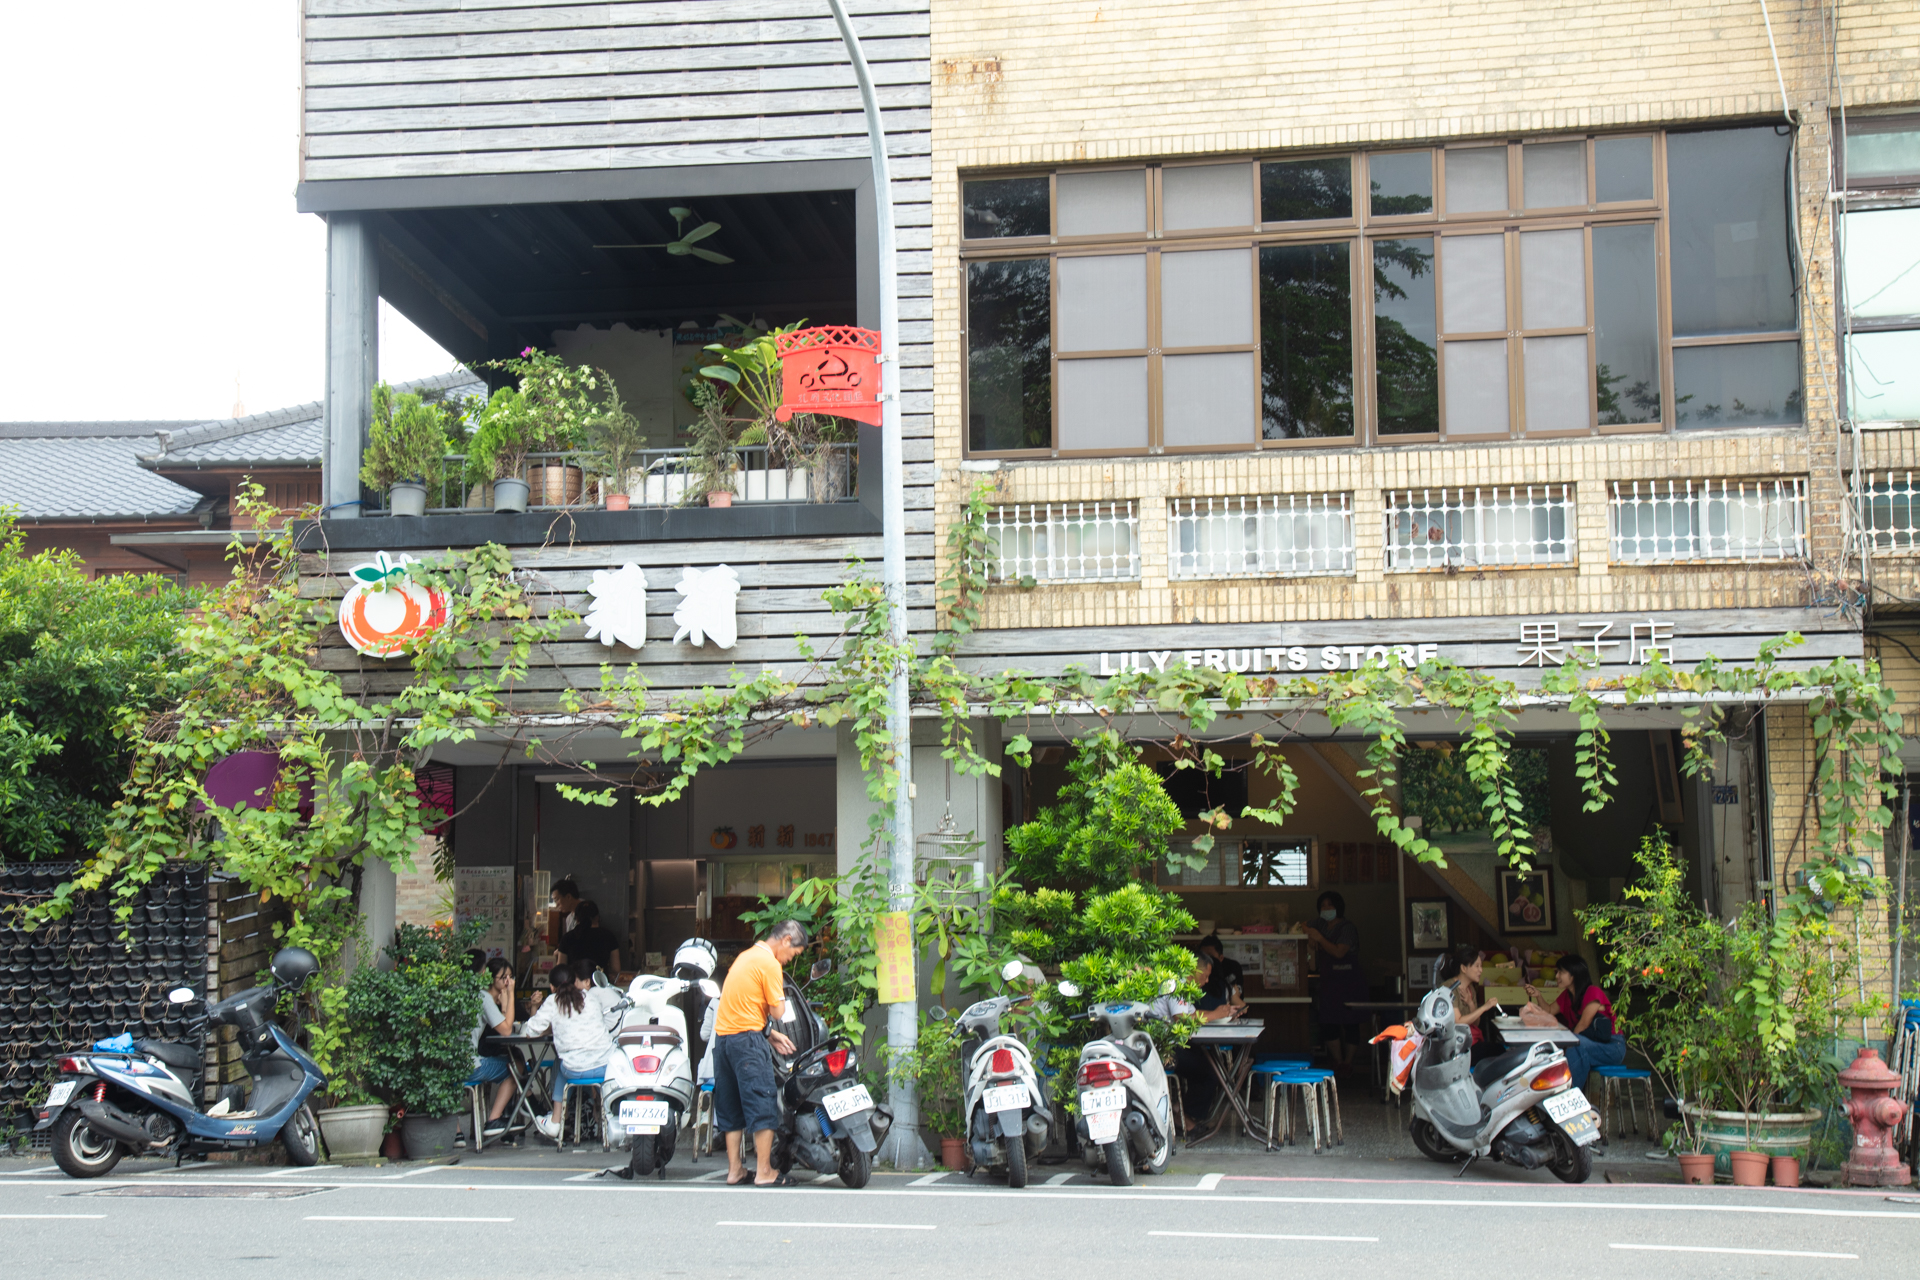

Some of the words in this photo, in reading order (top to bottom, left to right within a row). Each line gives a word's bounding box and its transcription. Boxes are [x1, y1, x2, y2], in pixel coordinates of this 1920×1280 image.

[1516, 618, 1675, 667] 果子店
[1100, 650, 1172, 675] LILY
[1184, 646, 1308, 673] FRUITS
[1320, 643, 1438, 671] STORE
[747, 823, 795, 848] 莉莉
